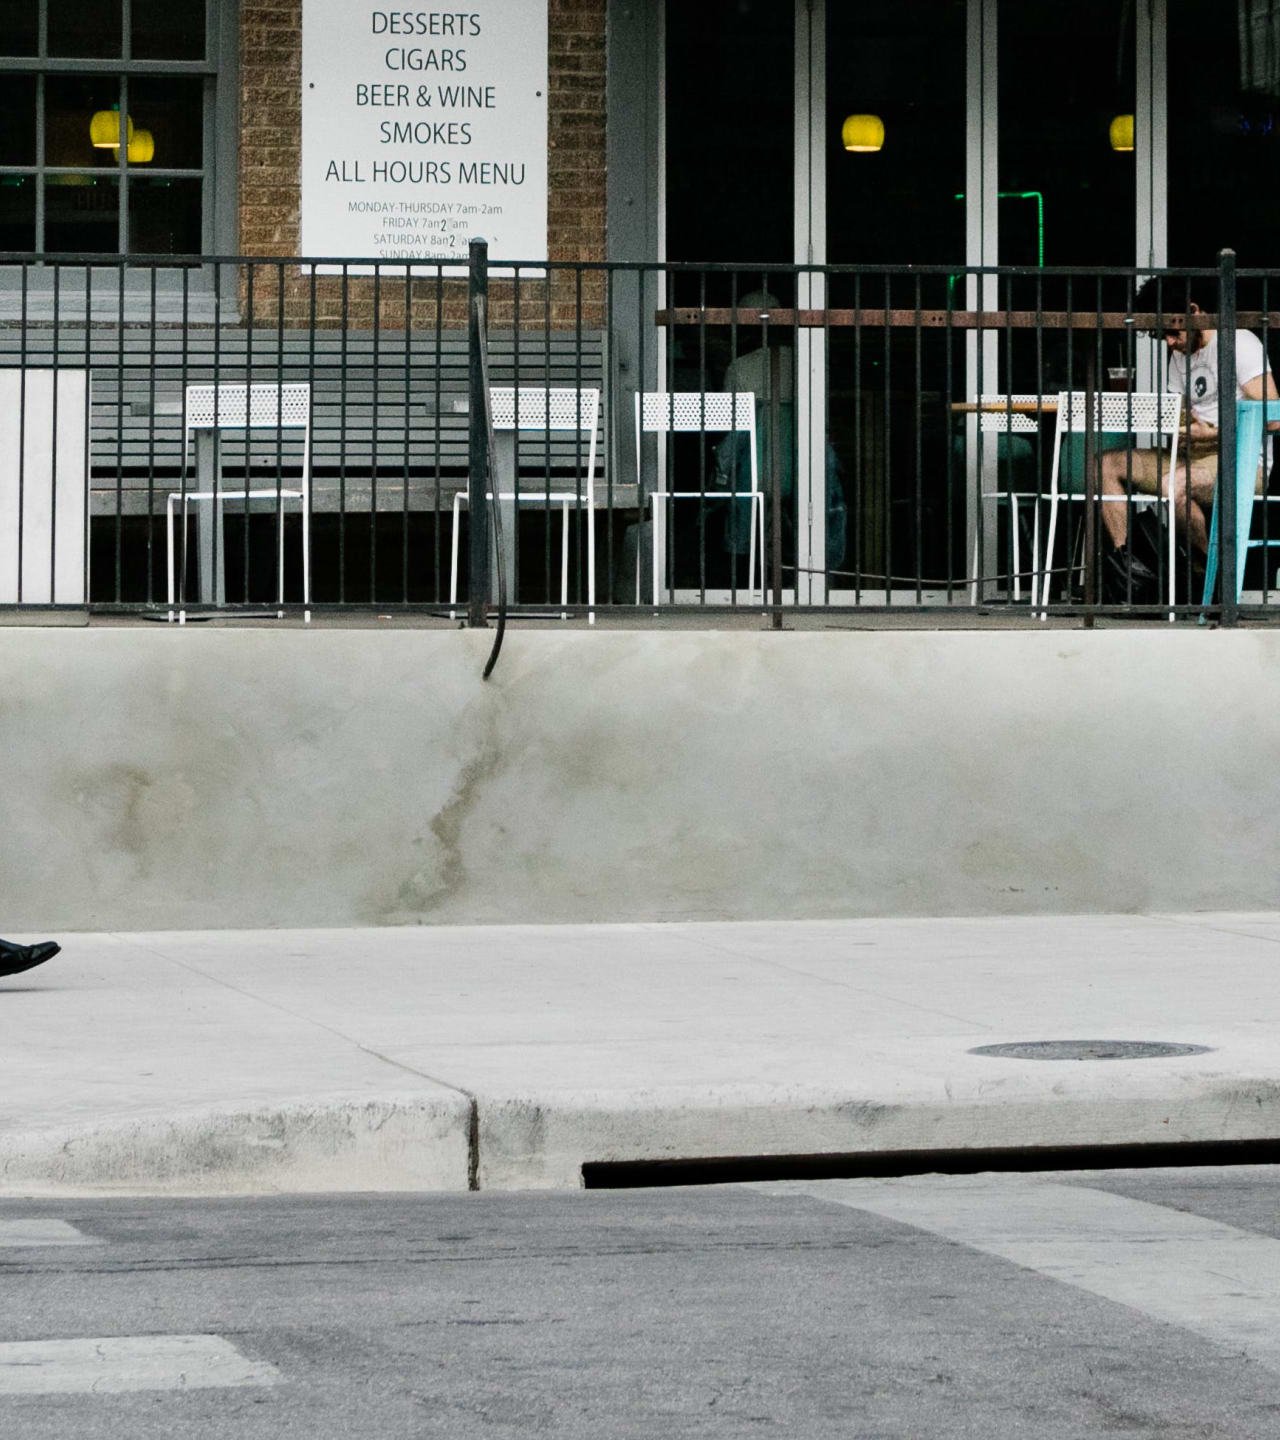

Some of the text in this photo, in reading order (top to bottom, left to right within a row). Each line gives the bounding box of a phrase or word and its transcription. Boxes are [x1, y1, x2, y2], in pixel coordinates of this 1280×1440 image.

[372, 11, 481, 37] DESSERTS
[385, 48, 467, 72] CIGARS
[356, 84, 497, 109] BEER & WINE
[379, 121, 472, 146] SMOKES
[325, 160, 526, 185] ALL HOURS MENU
[348, 201, 503, 215] MONDAY-THURSDAY 7am-2am
[382, 217, 419, 228] FRIDAY
[373, 234, 428, 245] SATURDAY
[379, 249, 425, 259] SUNDAY
